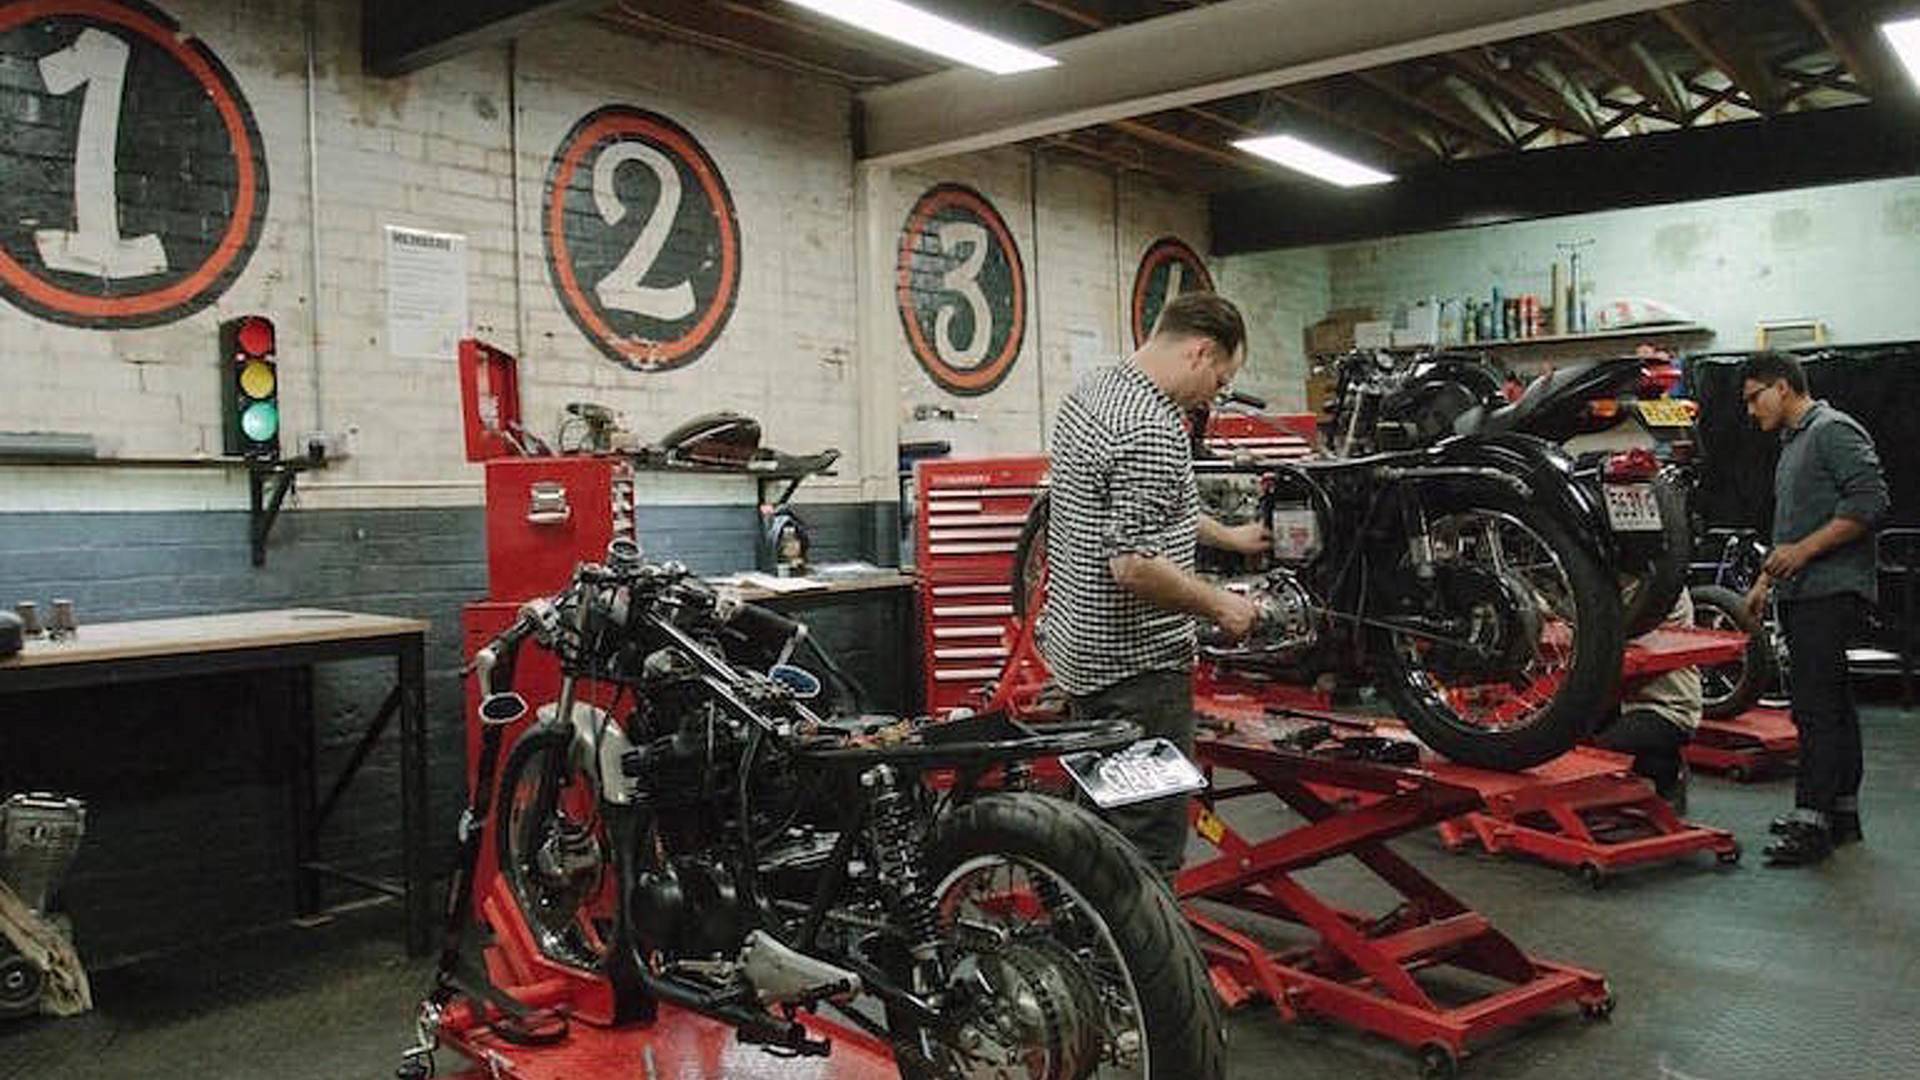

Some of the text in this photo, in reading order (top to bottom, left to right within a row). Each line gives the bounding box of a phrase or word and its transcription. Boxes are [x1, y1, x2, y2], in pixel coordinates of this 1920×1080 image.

[37, 28, 168, 279] 1
[594, 141, 697, 322] 2
[935, 221, 993, 370] 3
